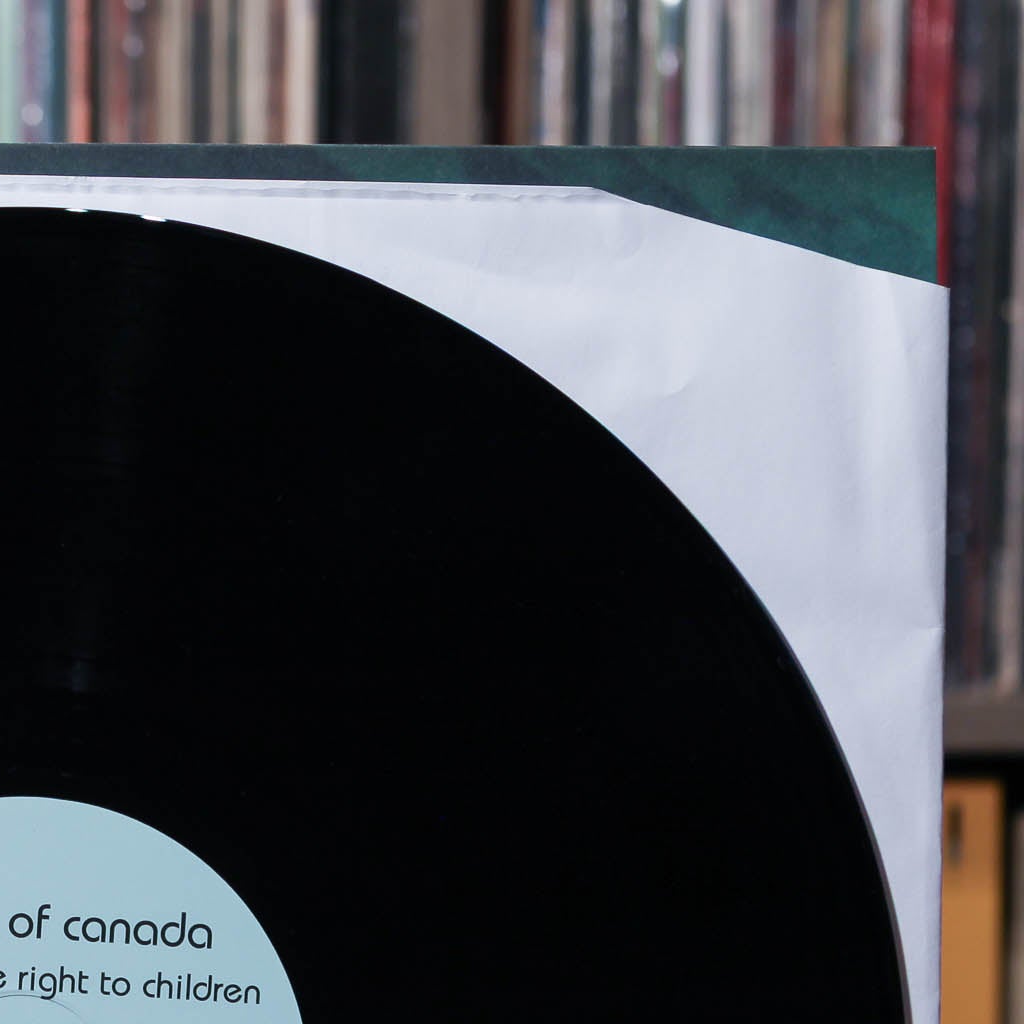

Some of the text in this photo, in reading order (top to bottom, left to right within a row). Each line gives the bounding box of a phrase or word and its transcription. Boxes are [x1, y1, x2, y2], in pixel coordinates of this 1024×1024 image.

[8, 904, 51, 939] of
[63, 912, 214, 949] canada
[18, 966, 89, 1000] right
[99, 971, 131, 998] to
[142, 971, 261, 1004] children
